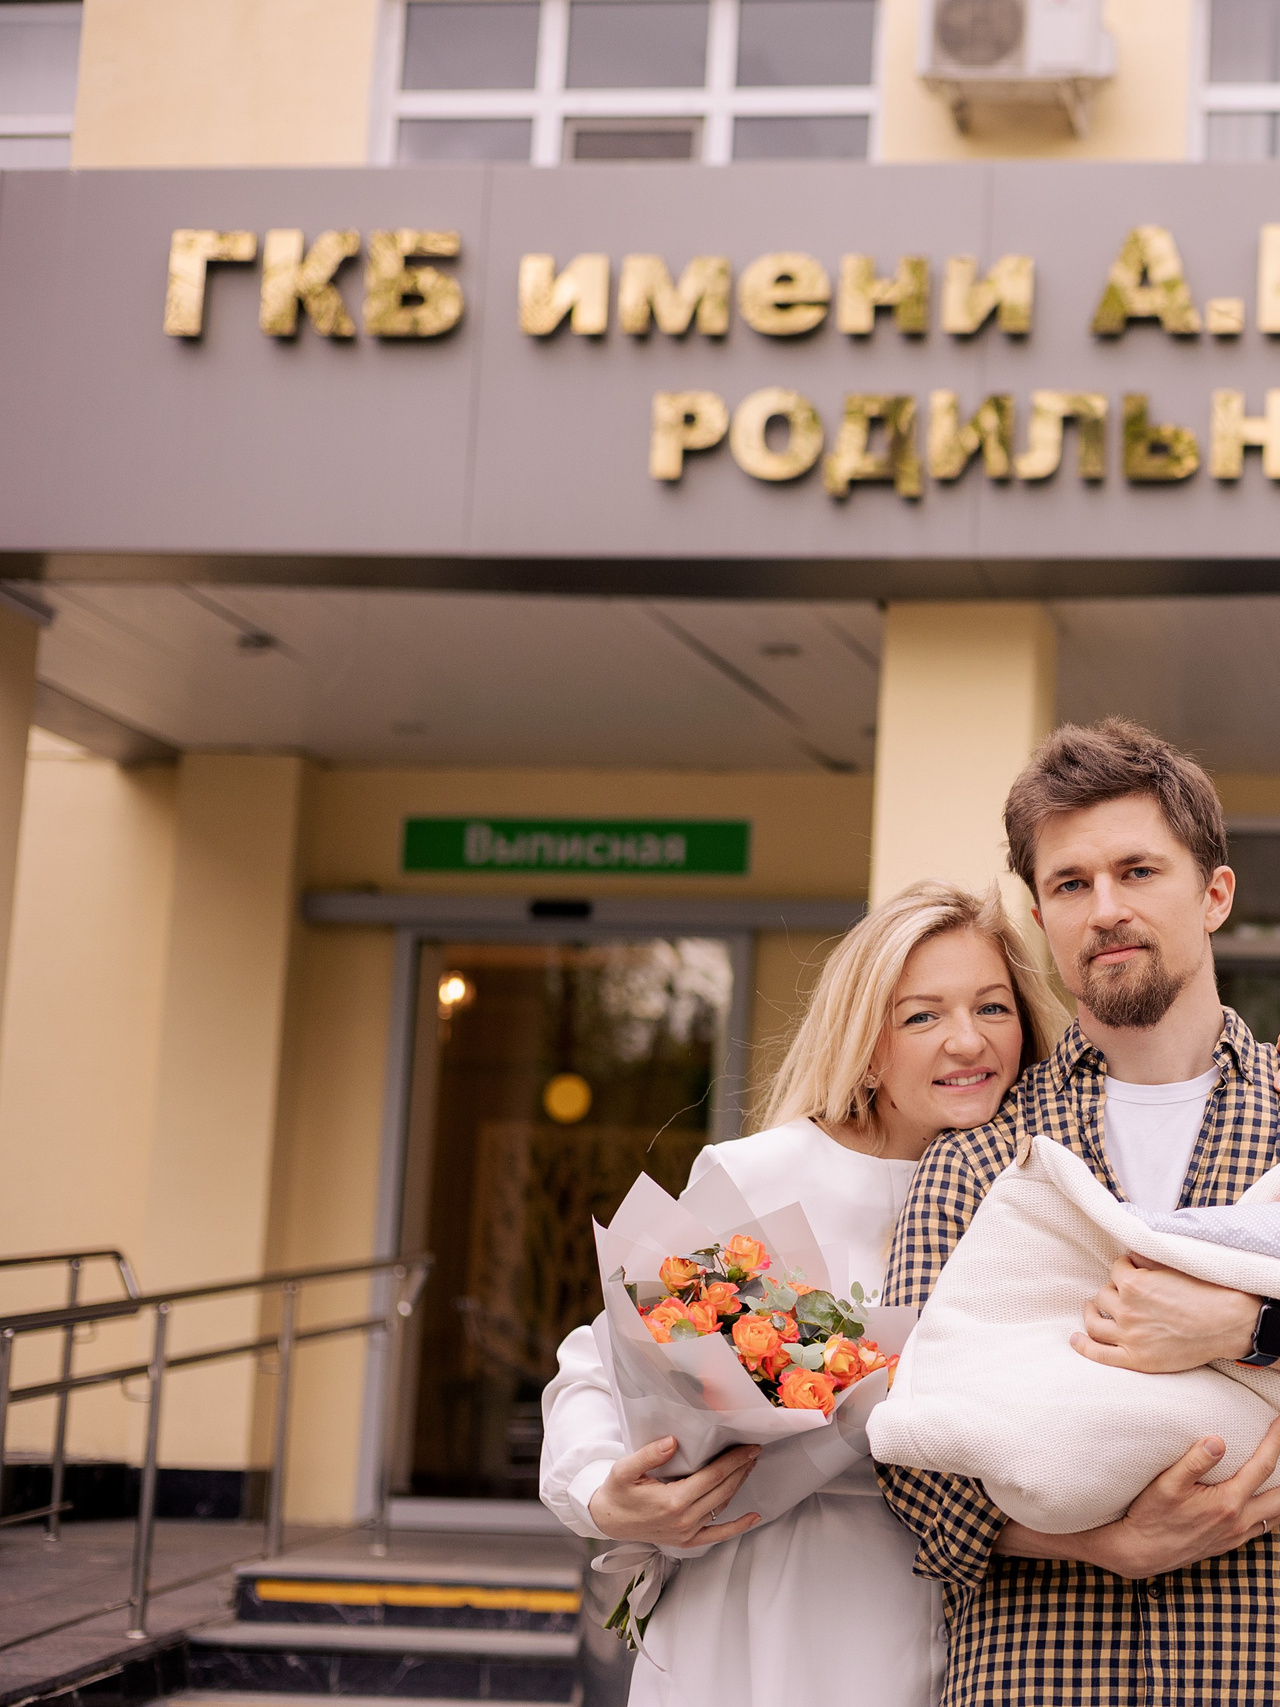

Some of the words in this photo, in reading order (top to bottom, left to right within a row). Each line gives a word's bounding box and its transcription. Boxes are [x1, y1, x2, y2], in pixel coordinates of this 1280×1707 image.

[163, 228, 466, 339] ГКБ
[518, 252, 1036, 337] имени
[464, 823, 687, 866] Выписная
